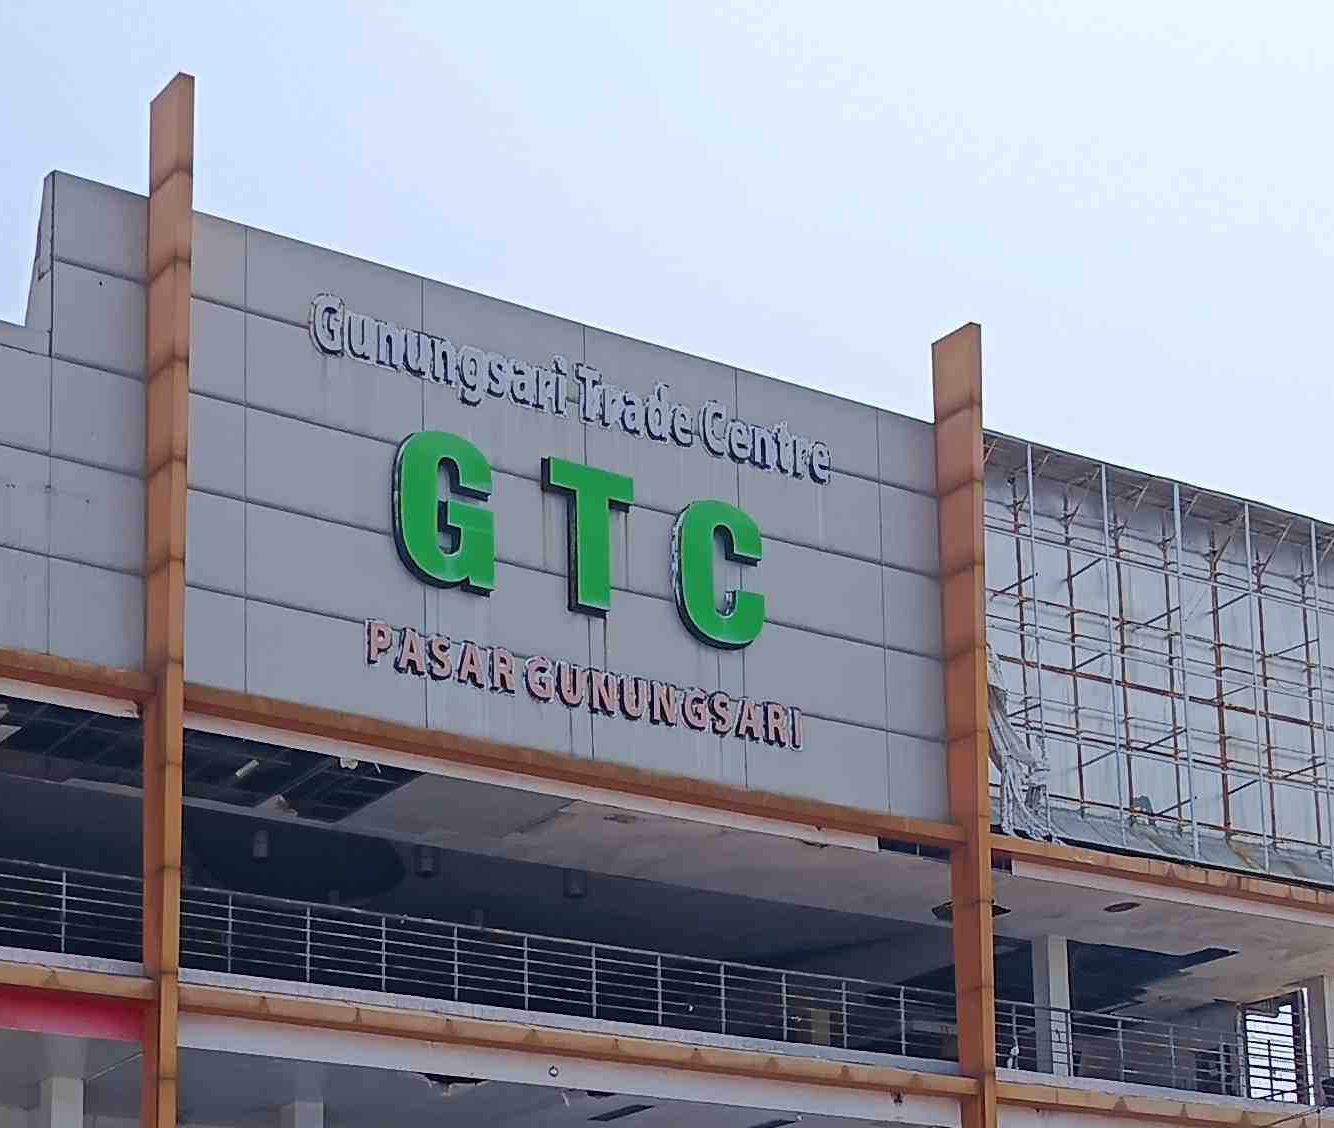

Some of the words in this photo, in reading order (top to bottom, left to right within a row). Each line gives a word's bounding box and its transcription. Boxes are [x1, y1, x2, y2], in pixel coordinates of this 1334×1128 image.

[309, 293, 567, 417] Gunungsari
[574, 362, 693, 447] Trade
[699, 400, 831, 485] Centre
[392, 430, 766, 650] GTC
[365, 619, 516, 697] PASAR
[524, 655, 804, 751] GUNUNGSARI
